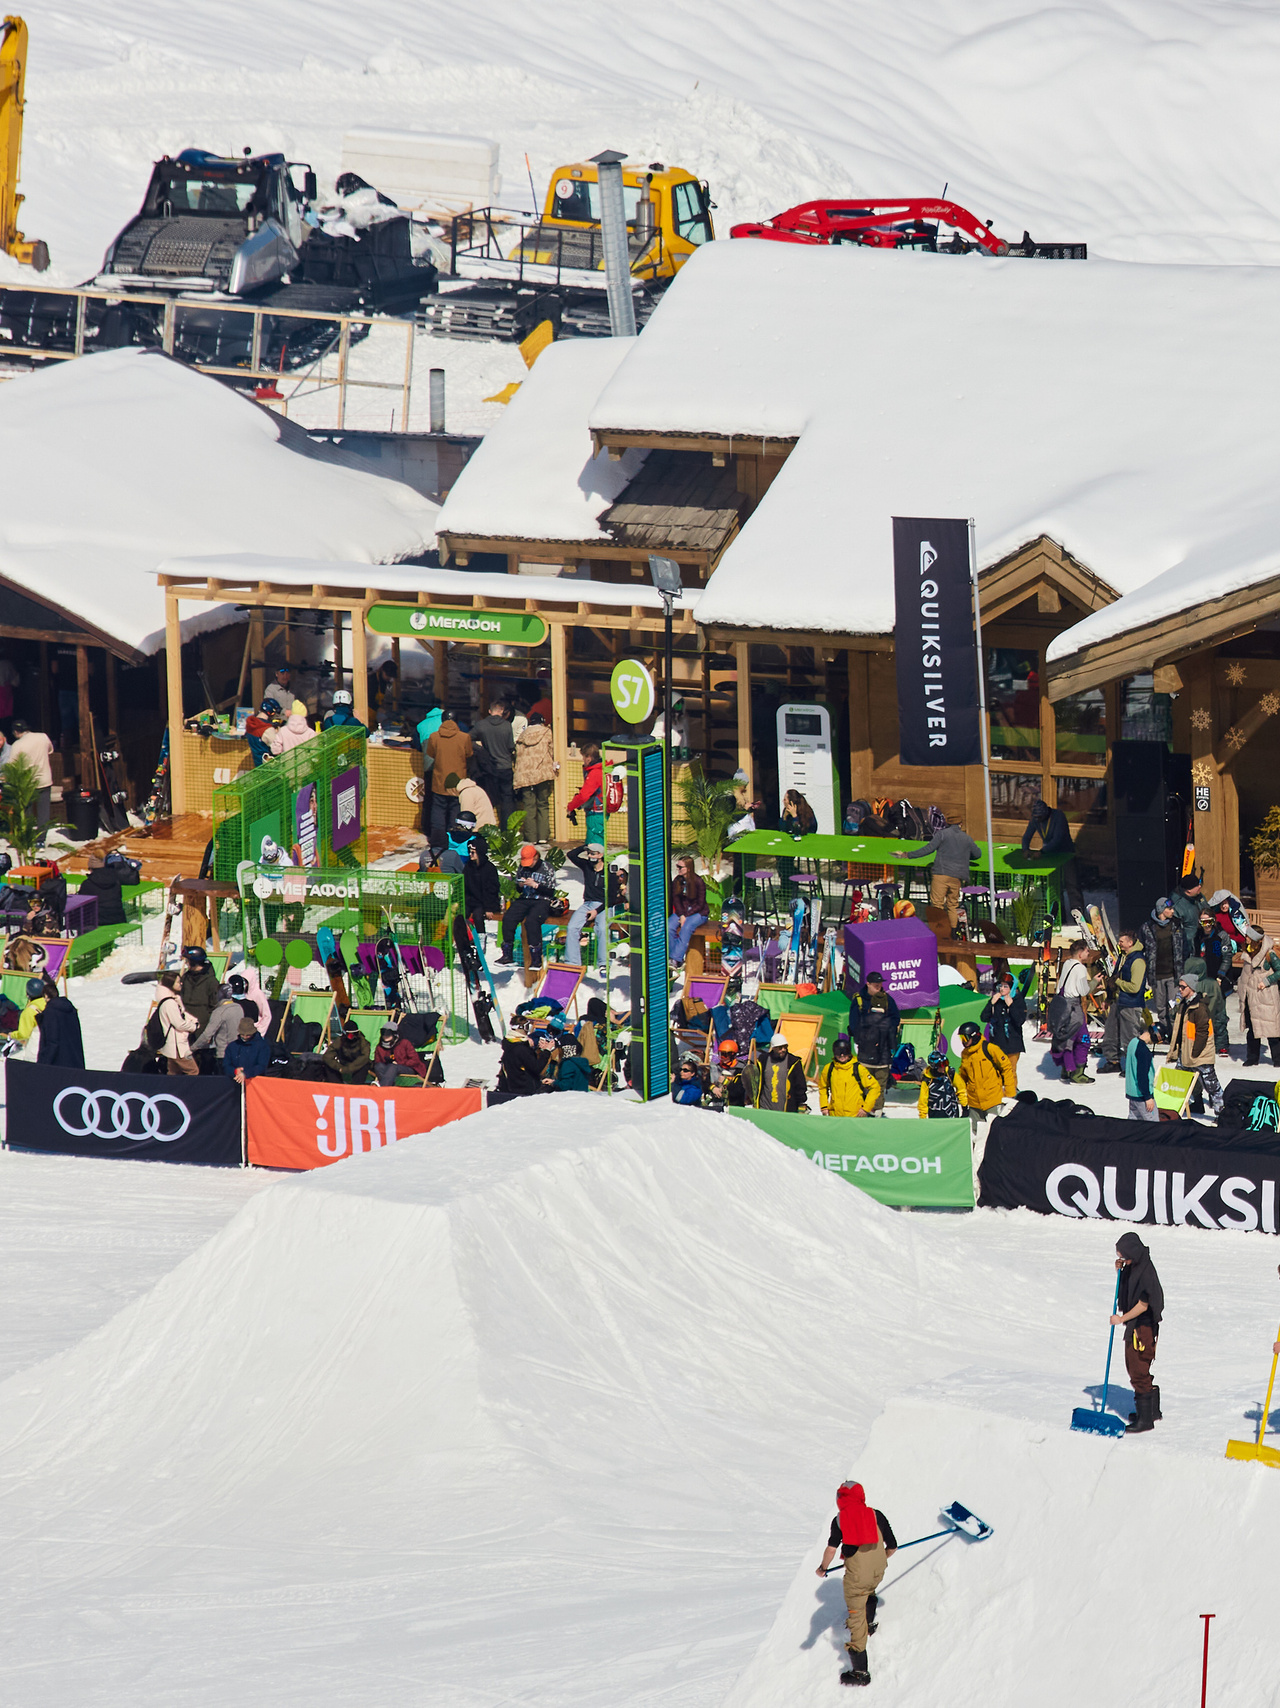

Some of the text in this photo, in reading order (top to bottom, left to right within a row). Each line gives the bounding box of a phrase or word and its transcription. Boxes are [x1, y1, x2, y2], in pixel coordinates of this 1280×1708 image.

[561, 185, 568, 195] 9
[920, 579, 947, 748] QUIKSILVER
[616, 674, 644, 709] S7
[1196, 787, 1209, 796] НЕ
[882, 959, 922, 971] НА NEW
[891, 971, 916, 981] STAR
[889, 980, 919, 991] CAMP
